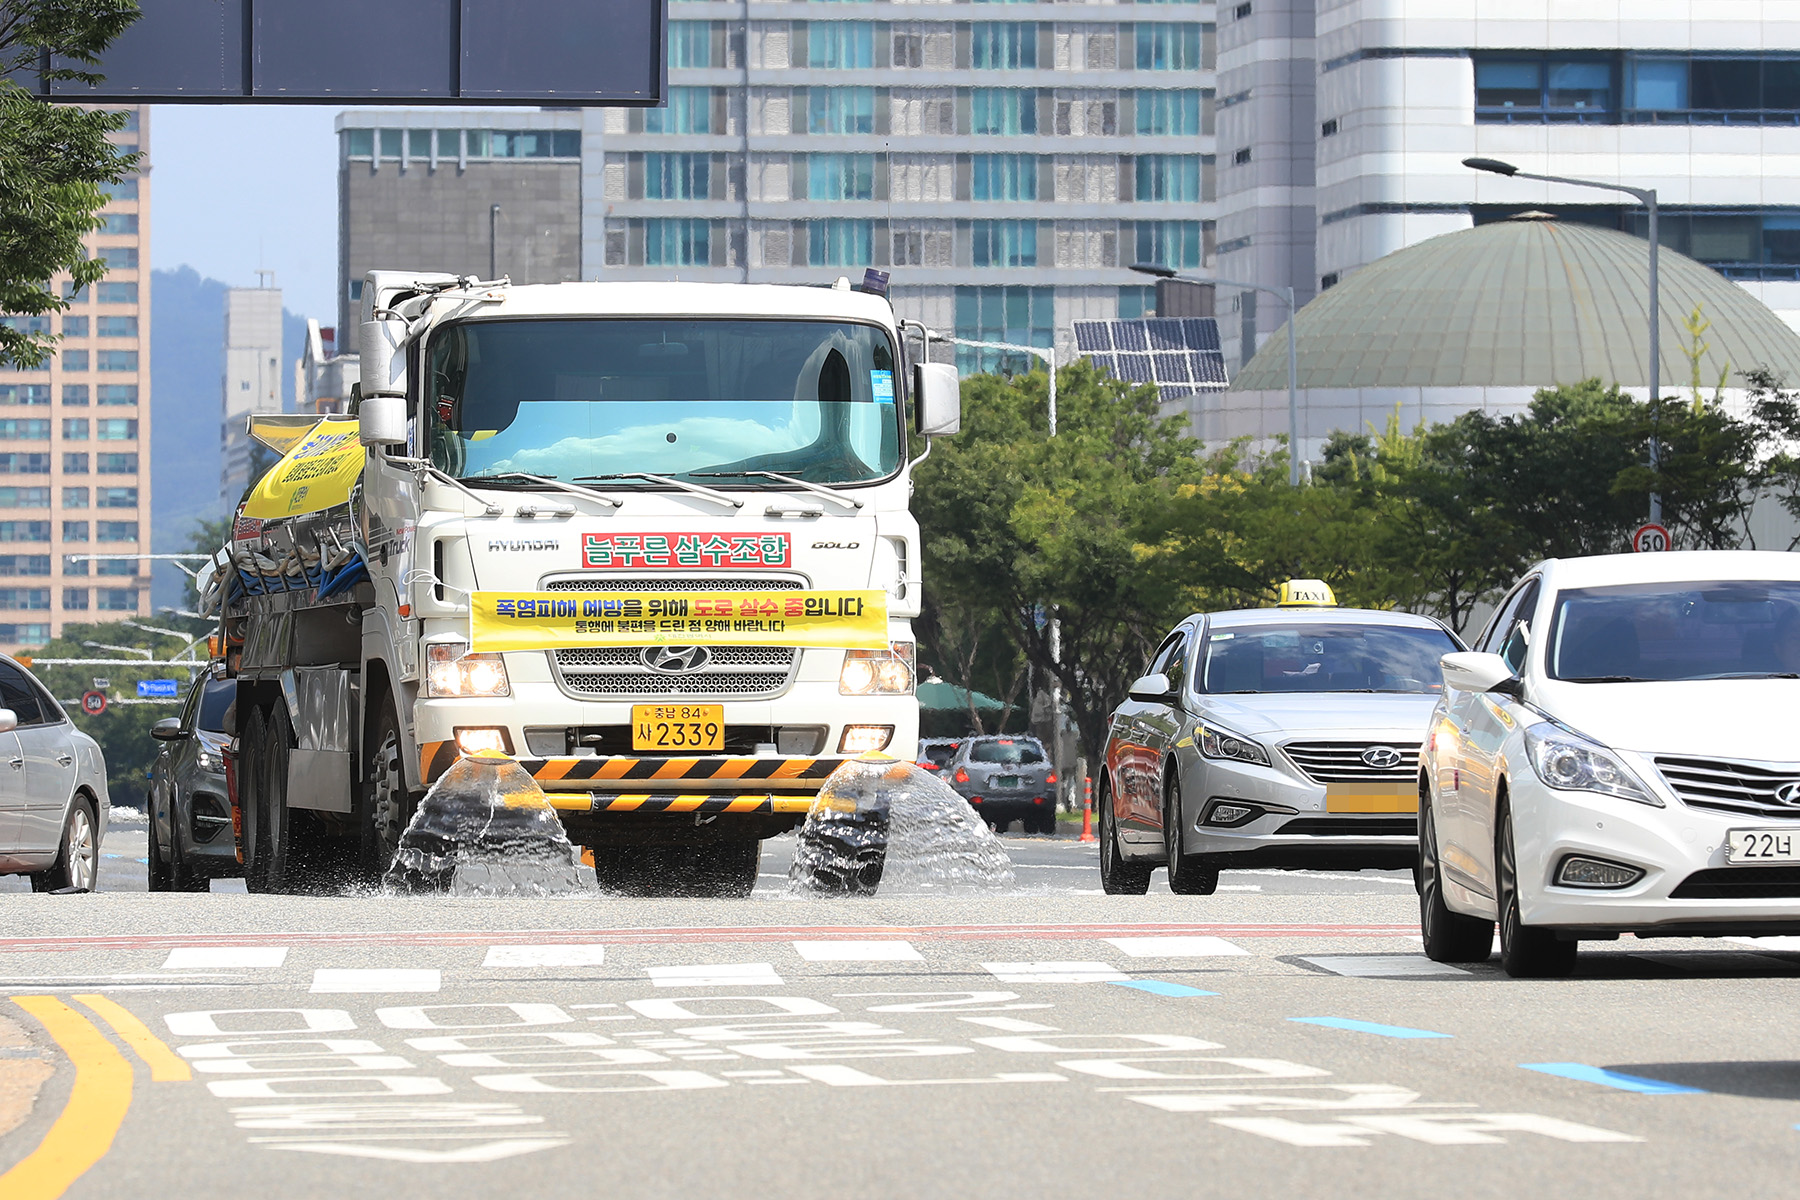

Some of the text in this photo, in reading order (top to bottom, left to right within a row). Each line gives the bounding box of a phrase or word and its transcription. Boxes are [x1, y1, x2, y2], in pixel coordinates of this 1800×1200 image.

[488, 539, 560, 552] HYUNDAI
[586, 535, 789, 567] 늘푸른 살수조합
[811, 540, 861, 550] GOLD
[1642, 534, 1664, 552] 50
[1293, 591, 1326, 601] TAXI
[496, 596, 864, 619] 폭염피해 예방을 위해 도로 살수 중입니다
[575, 619, 785, 634] 통행에 불편을 드린 점 양해 바랍니다
[655, 707, 701, 719] 충남 84
[637, 722, 718, 746] 사 2339
[1743, 833, 1791, 858] 22너
